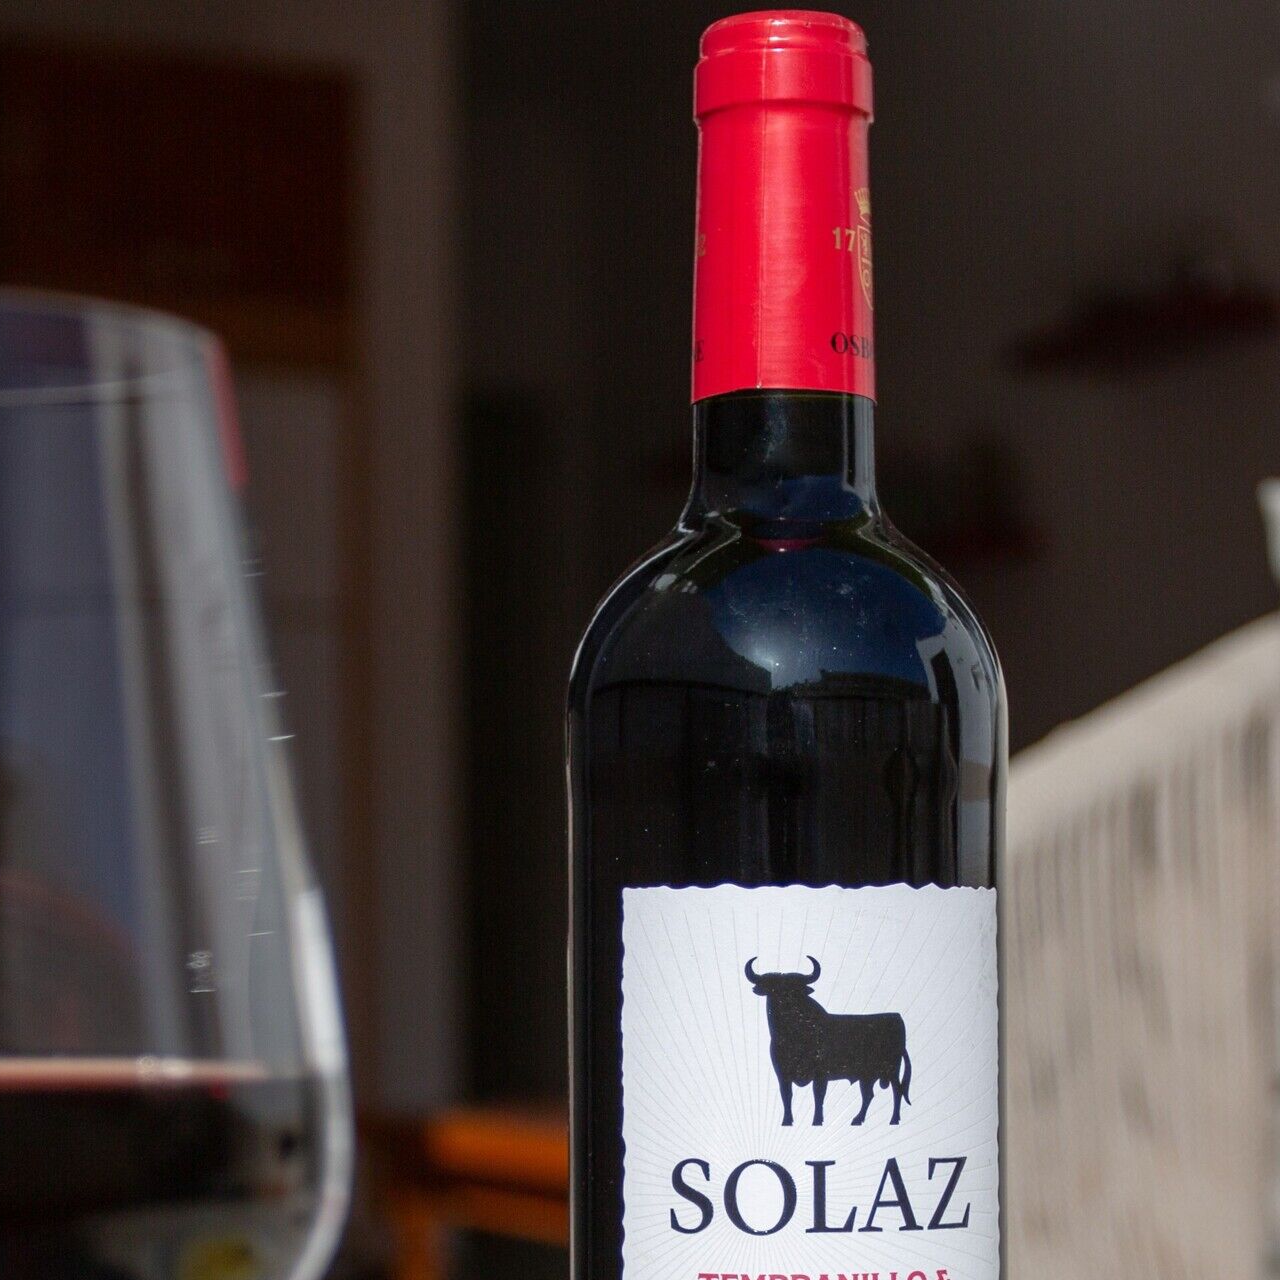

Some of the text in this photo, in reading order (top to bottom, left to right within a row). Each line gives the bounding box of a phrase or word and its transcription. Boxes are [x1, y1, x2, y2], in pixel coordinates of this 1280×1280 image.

[832, 226, 856, 252] 17
[830, 331, 873, 360] OSB
[670, 1157, 971, 1236] SOLAZ
